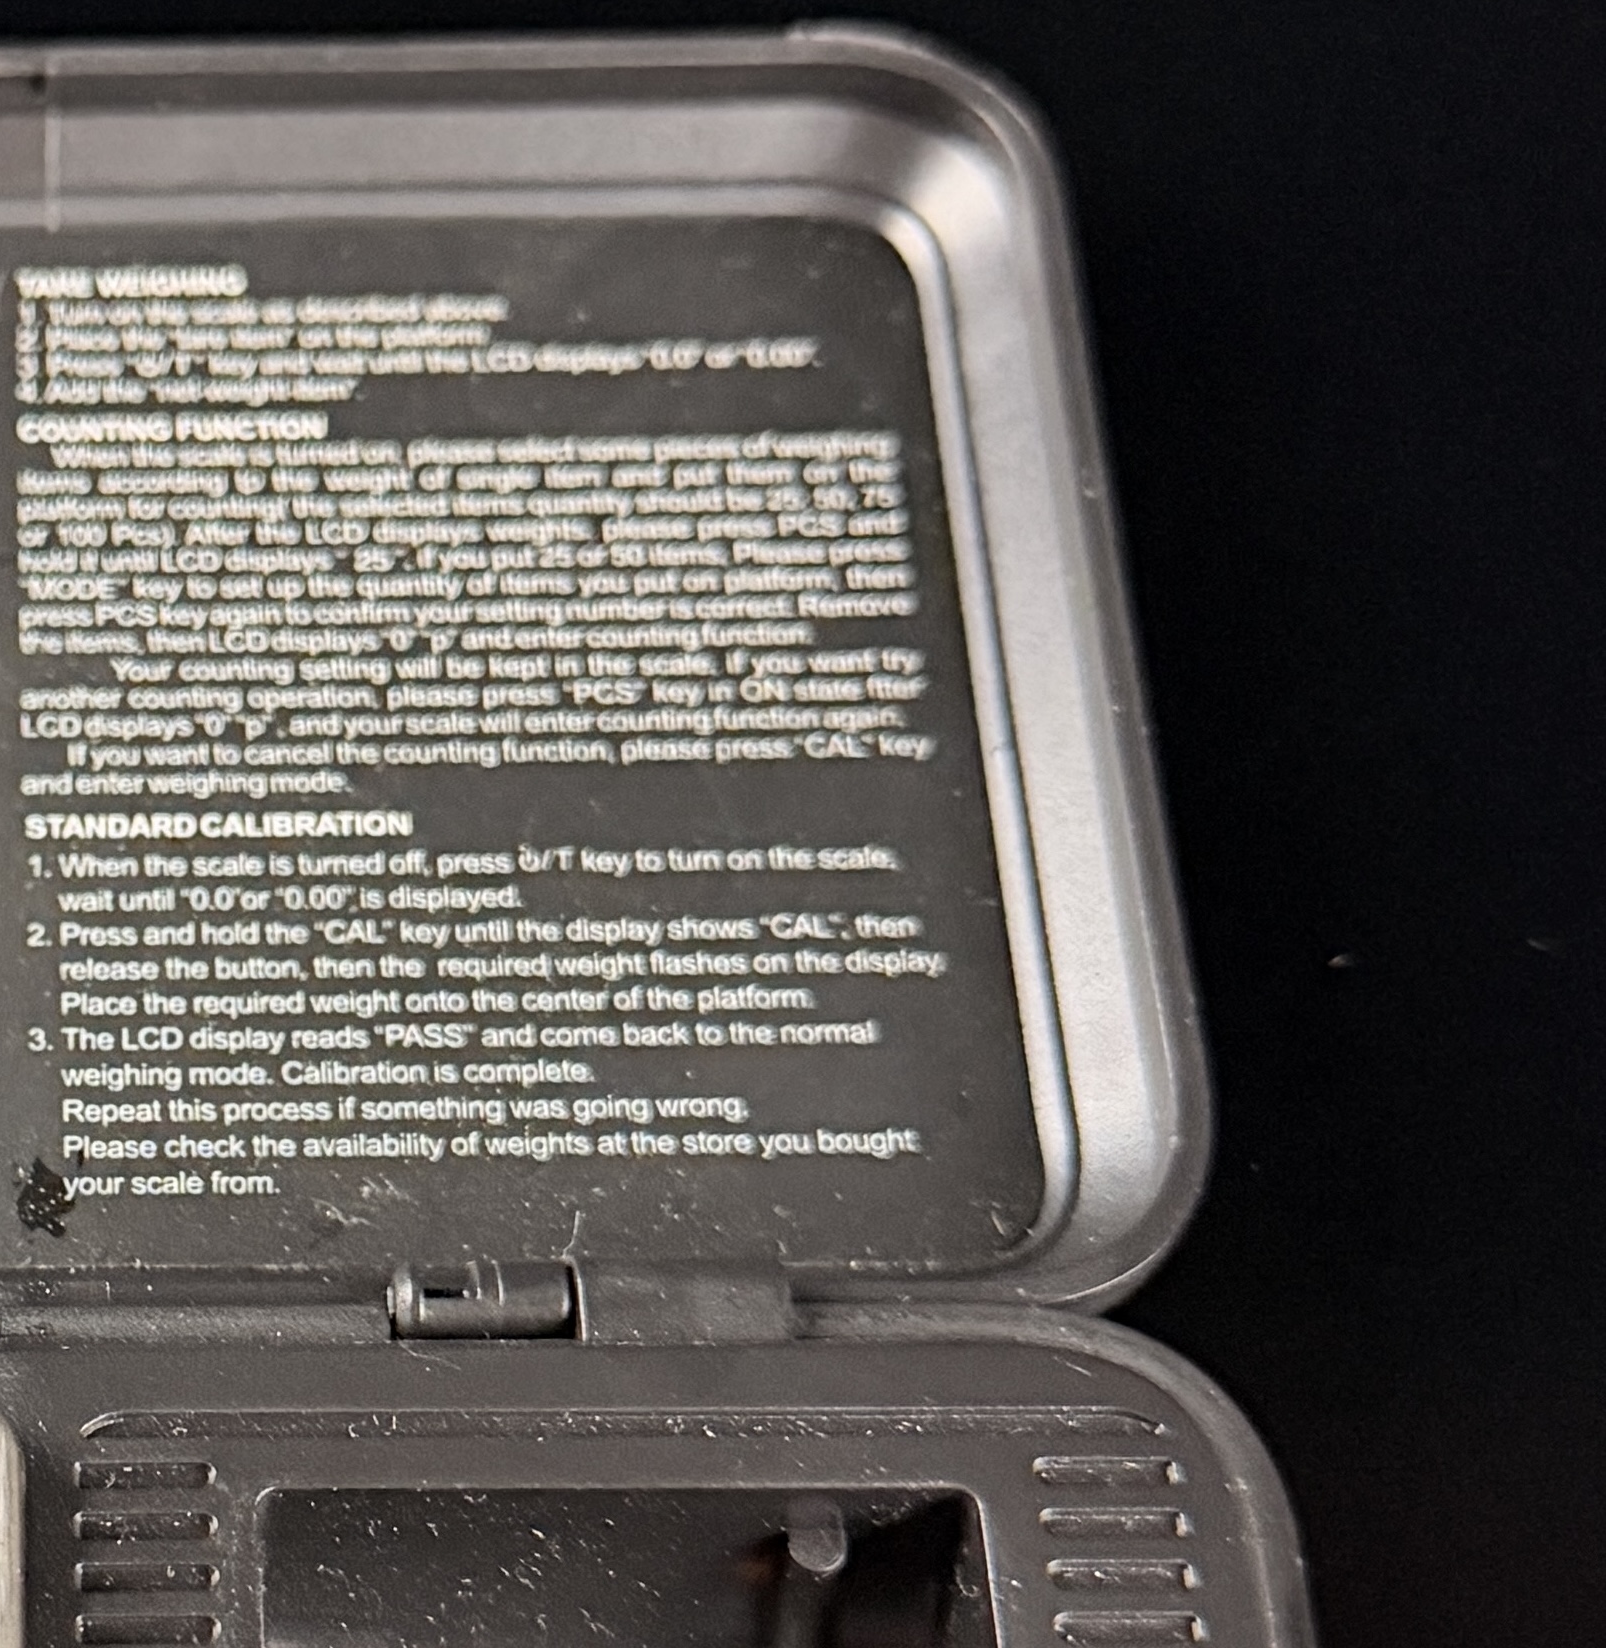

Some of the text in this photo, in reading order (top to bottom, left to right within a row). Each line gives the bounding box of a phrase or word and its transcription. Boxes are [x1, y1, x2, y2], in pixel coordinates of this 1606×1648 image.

[24, 811, 414, 839] STANDARD CALIBRATION
[58, 888, 113, 911] wait
[119, 887, 175, 910] until
[360, 886, 383, 908] is
[60, 922, 137, 945] Press
[144, 922, 195, 945] and
[201, 921, 260, 944] hold
[265, 920, 308, 943] the
[400, 919, 449, 948] key
[455, 918, 513, 941] until
[517, 918, 561, 941] the
[566, 917, 662, 947] display
[668, 916, 757, 939] shows
[60, 991, 137, 1015] Place
[143, 990, 186, 1014] the
[193, 990, 305, 1020] required
[311, 989, 400, 1019] weight
[406, 988, 467, 1012] onto
[473, 988, 517, 1011] the
[522, 987, 608, 1010] center
[614, 986, 642, 1010] of
[648, 986, 692, 1009] the
[62, 1027, 114, 1050] The
[122, 1027, 183, 1050] LCD
[190, 1026, 285, 1056] display
[292, 1025, 369, 1049] reads
[482, 1023, 536, 1047] and
[541, 1026, 619, 1046] come
[623, 1022, 689, 1046] back
[696, 1022, 723, 1045] to
[730, 1021, 774, 1045] the
[60, 1063, 182, 1092] weighing
[282, 1061, 428, 1084] Calibration
[434, 1061, 457, 1083] is
[62, 1099, 161, 1127] Repeat
[169, 1098, 216, 1120] this
[224, 1101, 332, 1126] process
[339, 1098, 355, 1119] if
[362, 1097, 506, 1125] something
[511, 1100, 568, 1118] was
[574, 1097, 653, 1124] going
[62, 1136, 157, 1157] Please
[165, 1135, 245, 1156] check
[253, 1134, 296, 1156] the
[304, 1133, 444, 1162] availability
[452, 1133, 479, 1155] of
[486, 1132, 592, 1161] weights
[599, 1132, 626, 1154] at
[632, 1131, 676, 1154] the
[683, 1131, 754, 1154] store
[63, 1174, 122, 1200] your
[132, 1171, 203, 1194] scale
